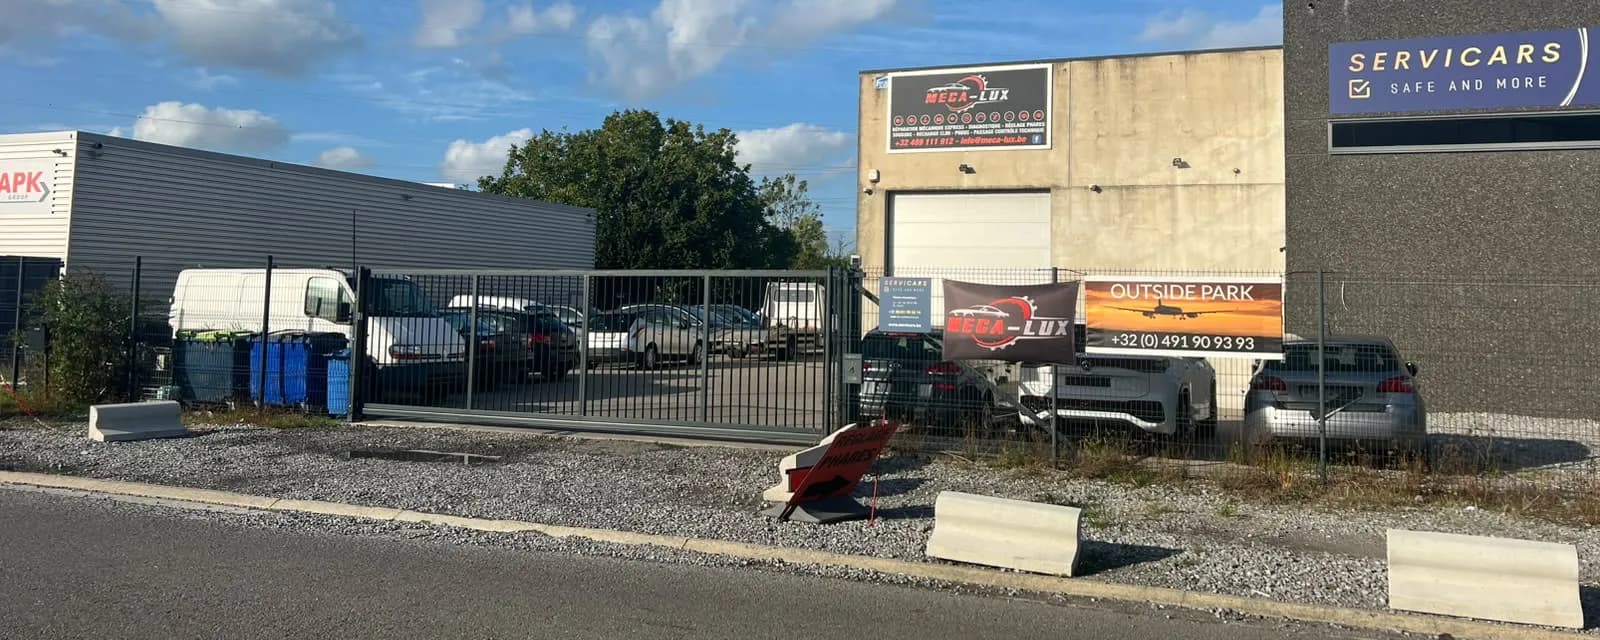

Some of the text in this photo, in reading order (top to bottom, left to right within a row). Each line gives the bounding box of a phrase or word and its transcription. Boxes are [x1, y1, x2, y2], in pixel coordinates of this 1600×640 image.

[1349, 42, 1561, 72] SERVICARS
[1391, 76, 1547, 94] SAFE AND MORE
[0, 171, 43, 193] APK
[1110, 283, 1255, 301] OUTSIDE PARK
[1112, 333, 1255, 350] +32 (0) 491 90 93 93
